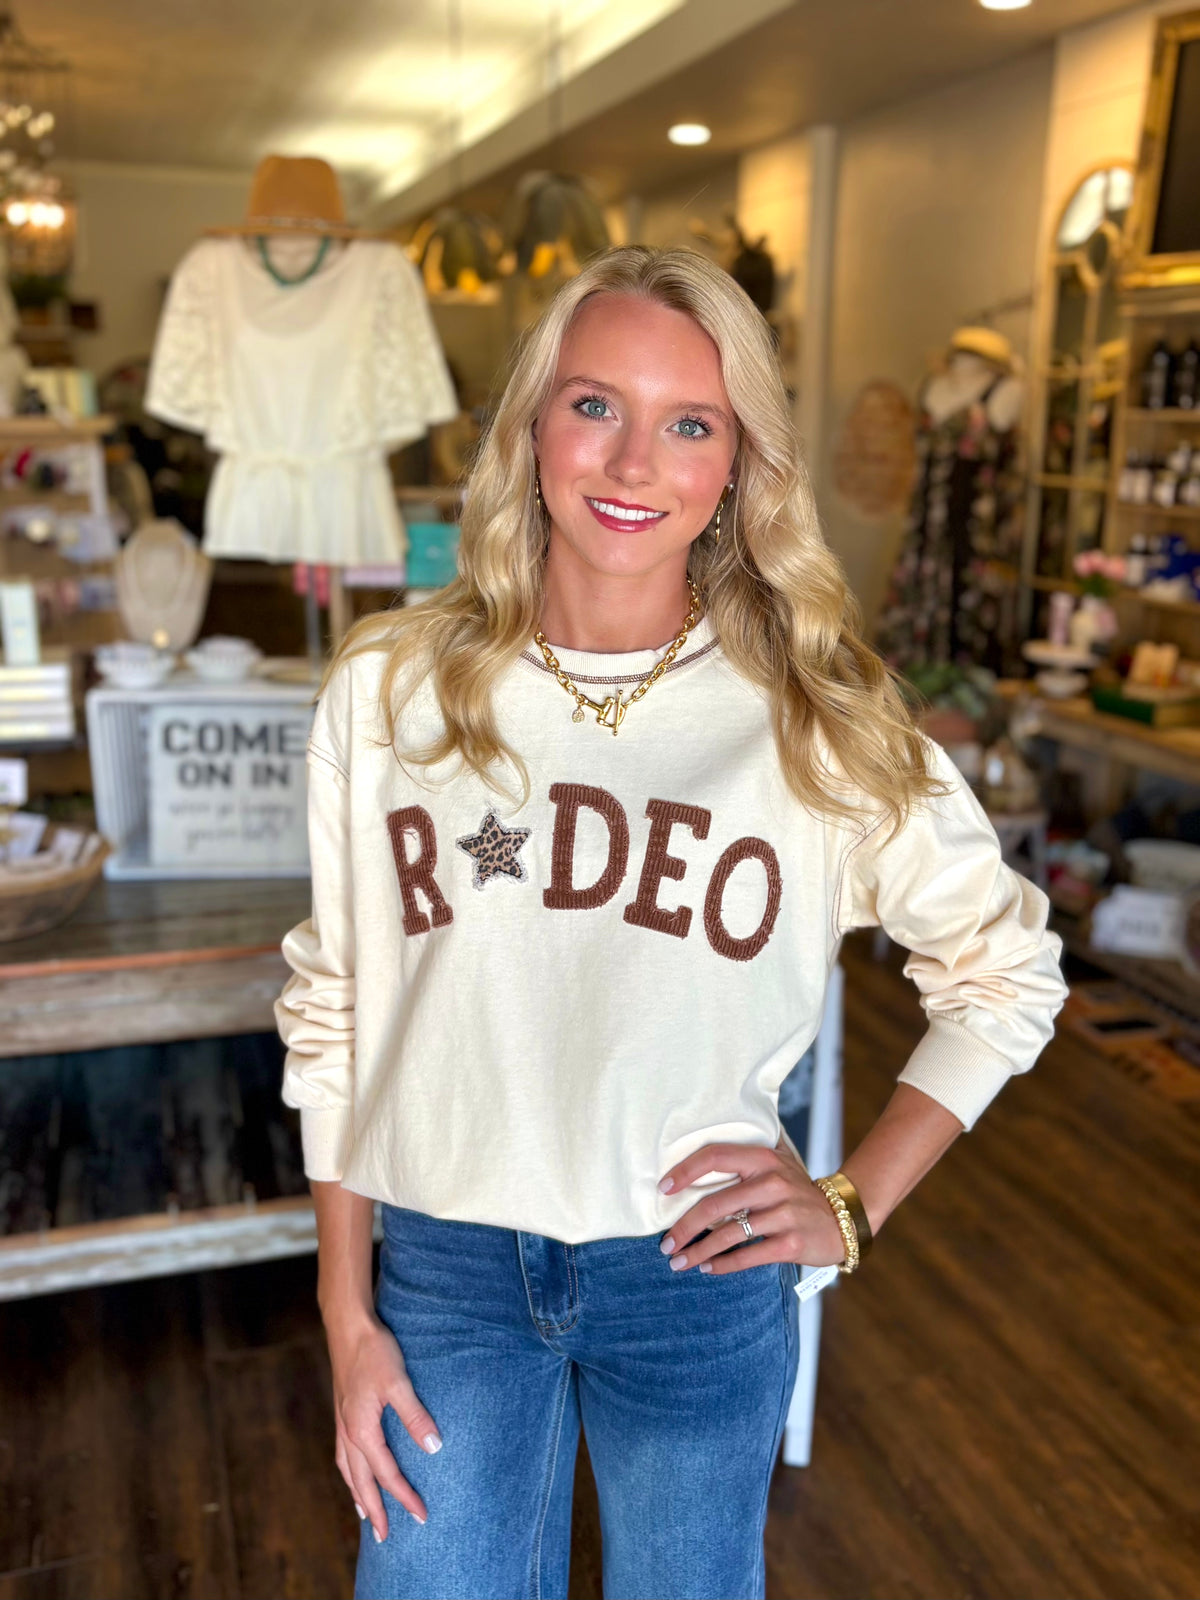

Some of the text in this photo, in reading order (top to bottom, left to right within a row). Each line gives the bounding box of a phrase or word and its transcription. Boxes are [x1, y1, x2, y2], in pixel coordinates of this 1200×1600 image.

[162, 719, 307, 757] COME
[178, 760, 290, 789] ON IN
